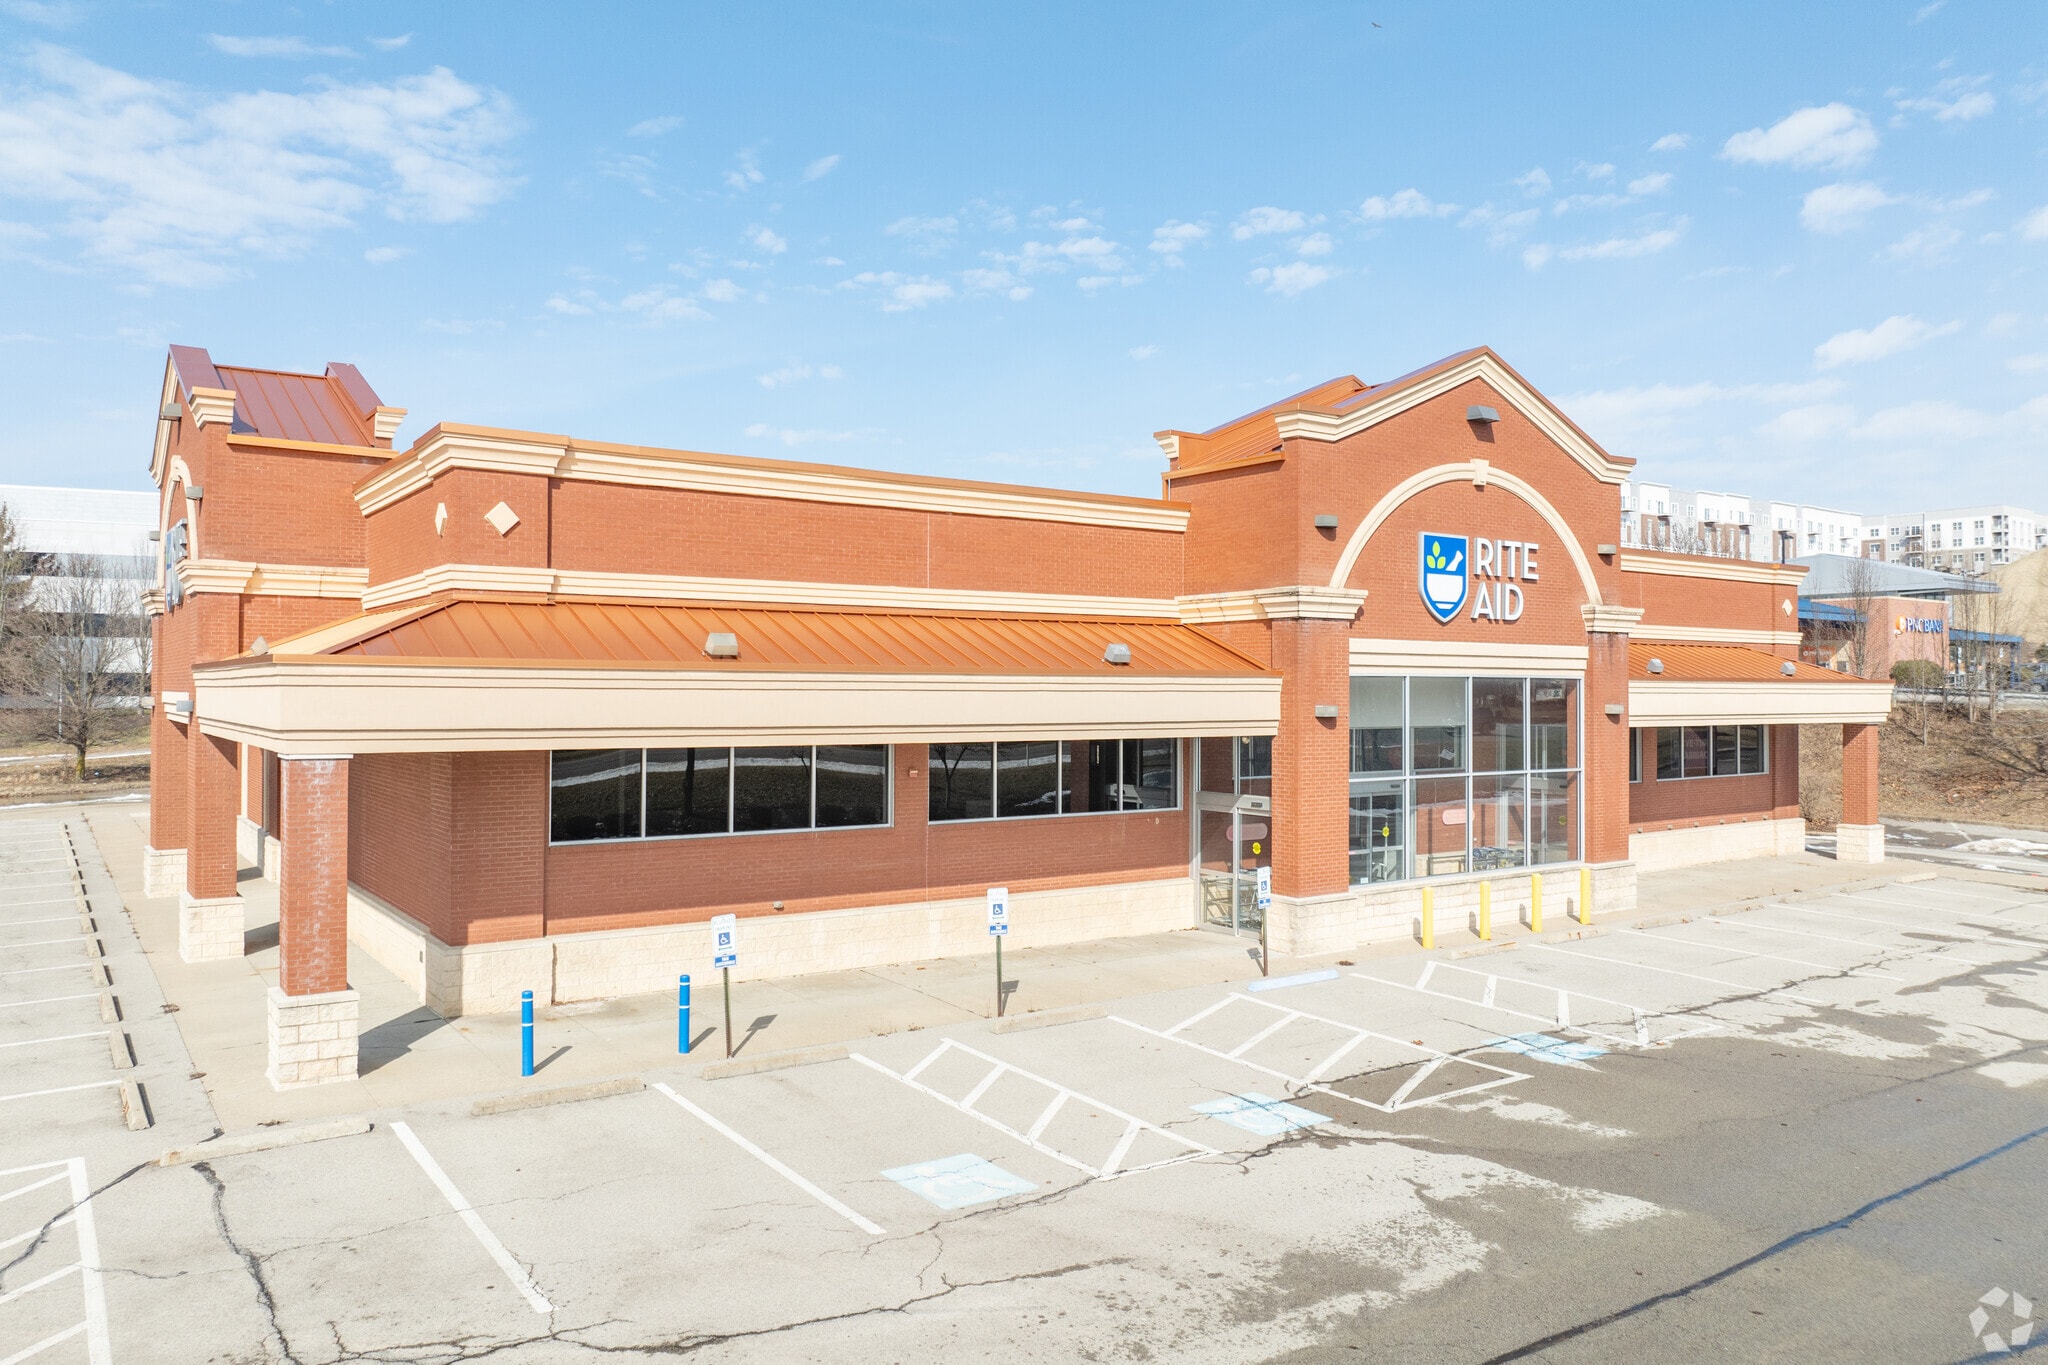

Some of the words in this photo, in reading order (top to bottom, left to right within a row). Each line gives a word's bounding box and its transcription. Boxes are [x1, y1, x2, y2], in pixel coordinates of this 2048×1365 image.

[1473, 537, 1539, 580] RITE
[1470, 581, 1525, 621] AID
[1906, 617, 1924, 632] PNC
